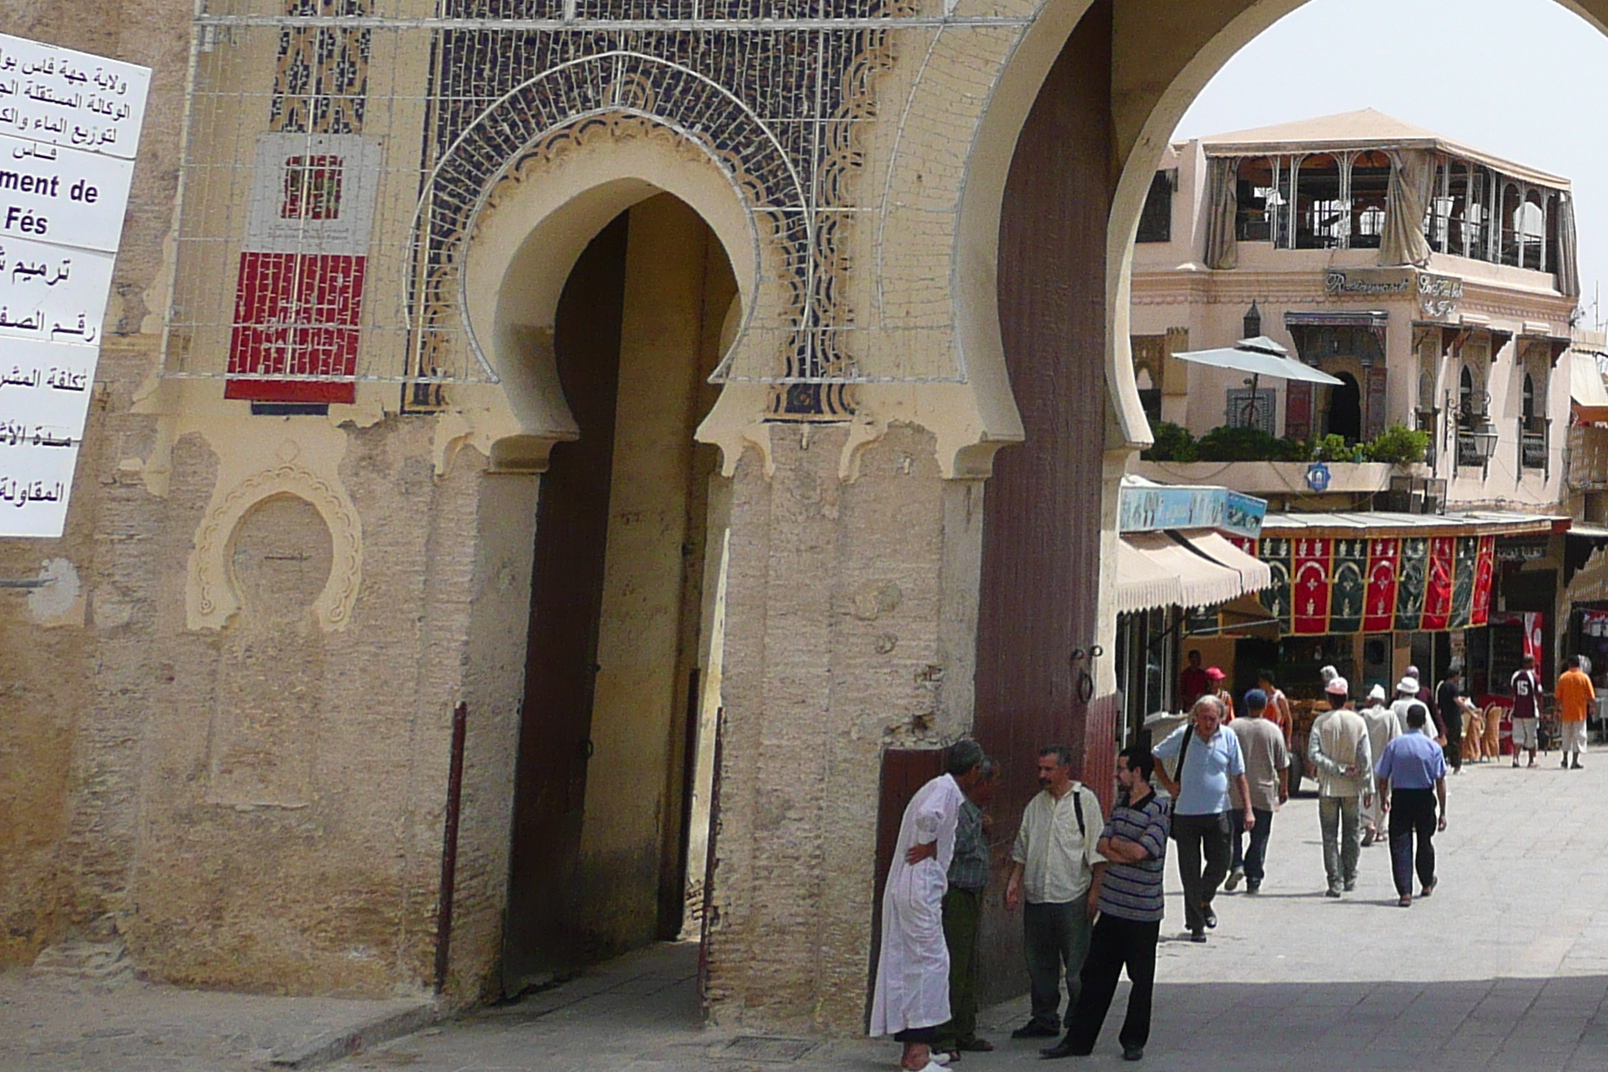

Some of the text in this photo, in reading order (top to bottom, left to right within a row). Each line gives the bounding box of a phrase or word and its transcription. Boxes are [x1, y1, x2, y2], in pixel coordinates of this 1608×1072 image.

[21, 56, 55, 75] فاس
[58, 59, 88, 86] جهة
[93, 67, 127, 95] ولاية
[23, 80, 83, 109] المستقلة
[86, 94, 131, 122] الوكالة
[34, 115, 67, 134] الماء
[71, 126, 117, 145] لتوزيع
[12, 139, 57, 161] فاس
[69, 178, 99, 203] de
[4, 206, 49, 235] Fés
[11, 257, 72, 286] ترميم
[50, 314, 97, 342] رقم
[46, 366, 88, 392] تكلفة
[32, 424, 73, 448] مدة
[0, 476, 65, 508] المقاولة
[1516, 680, 1529, 696] 15
